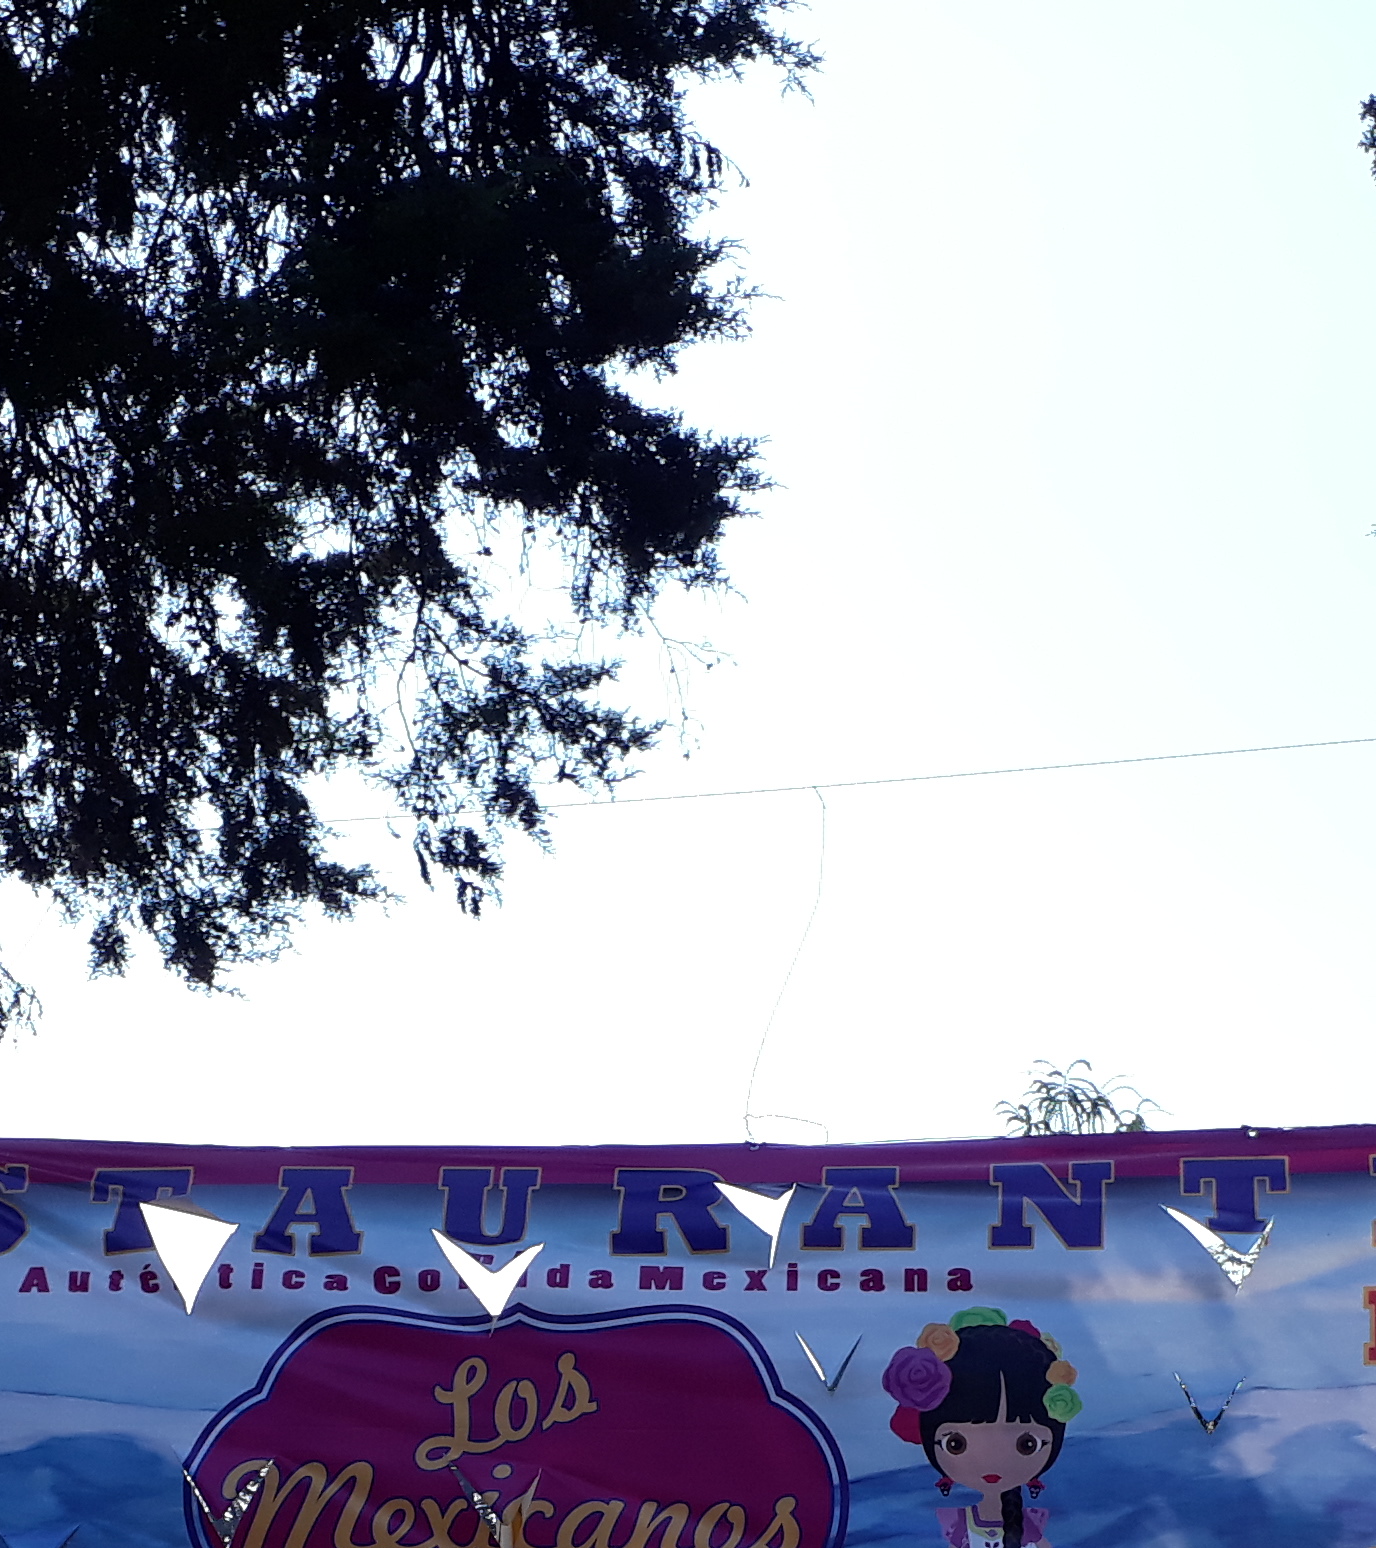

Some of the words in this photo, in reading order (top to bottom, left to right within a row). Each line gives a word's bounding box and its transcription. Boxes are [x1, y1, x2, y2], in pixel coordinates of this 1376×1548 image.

[18, 1262, 350, 1294] Autética
[373, 1258, 614, 1295] Coda
[638, 1262, 974, 1293] Mexicana
[414, 1352, 598, 1470] Los
